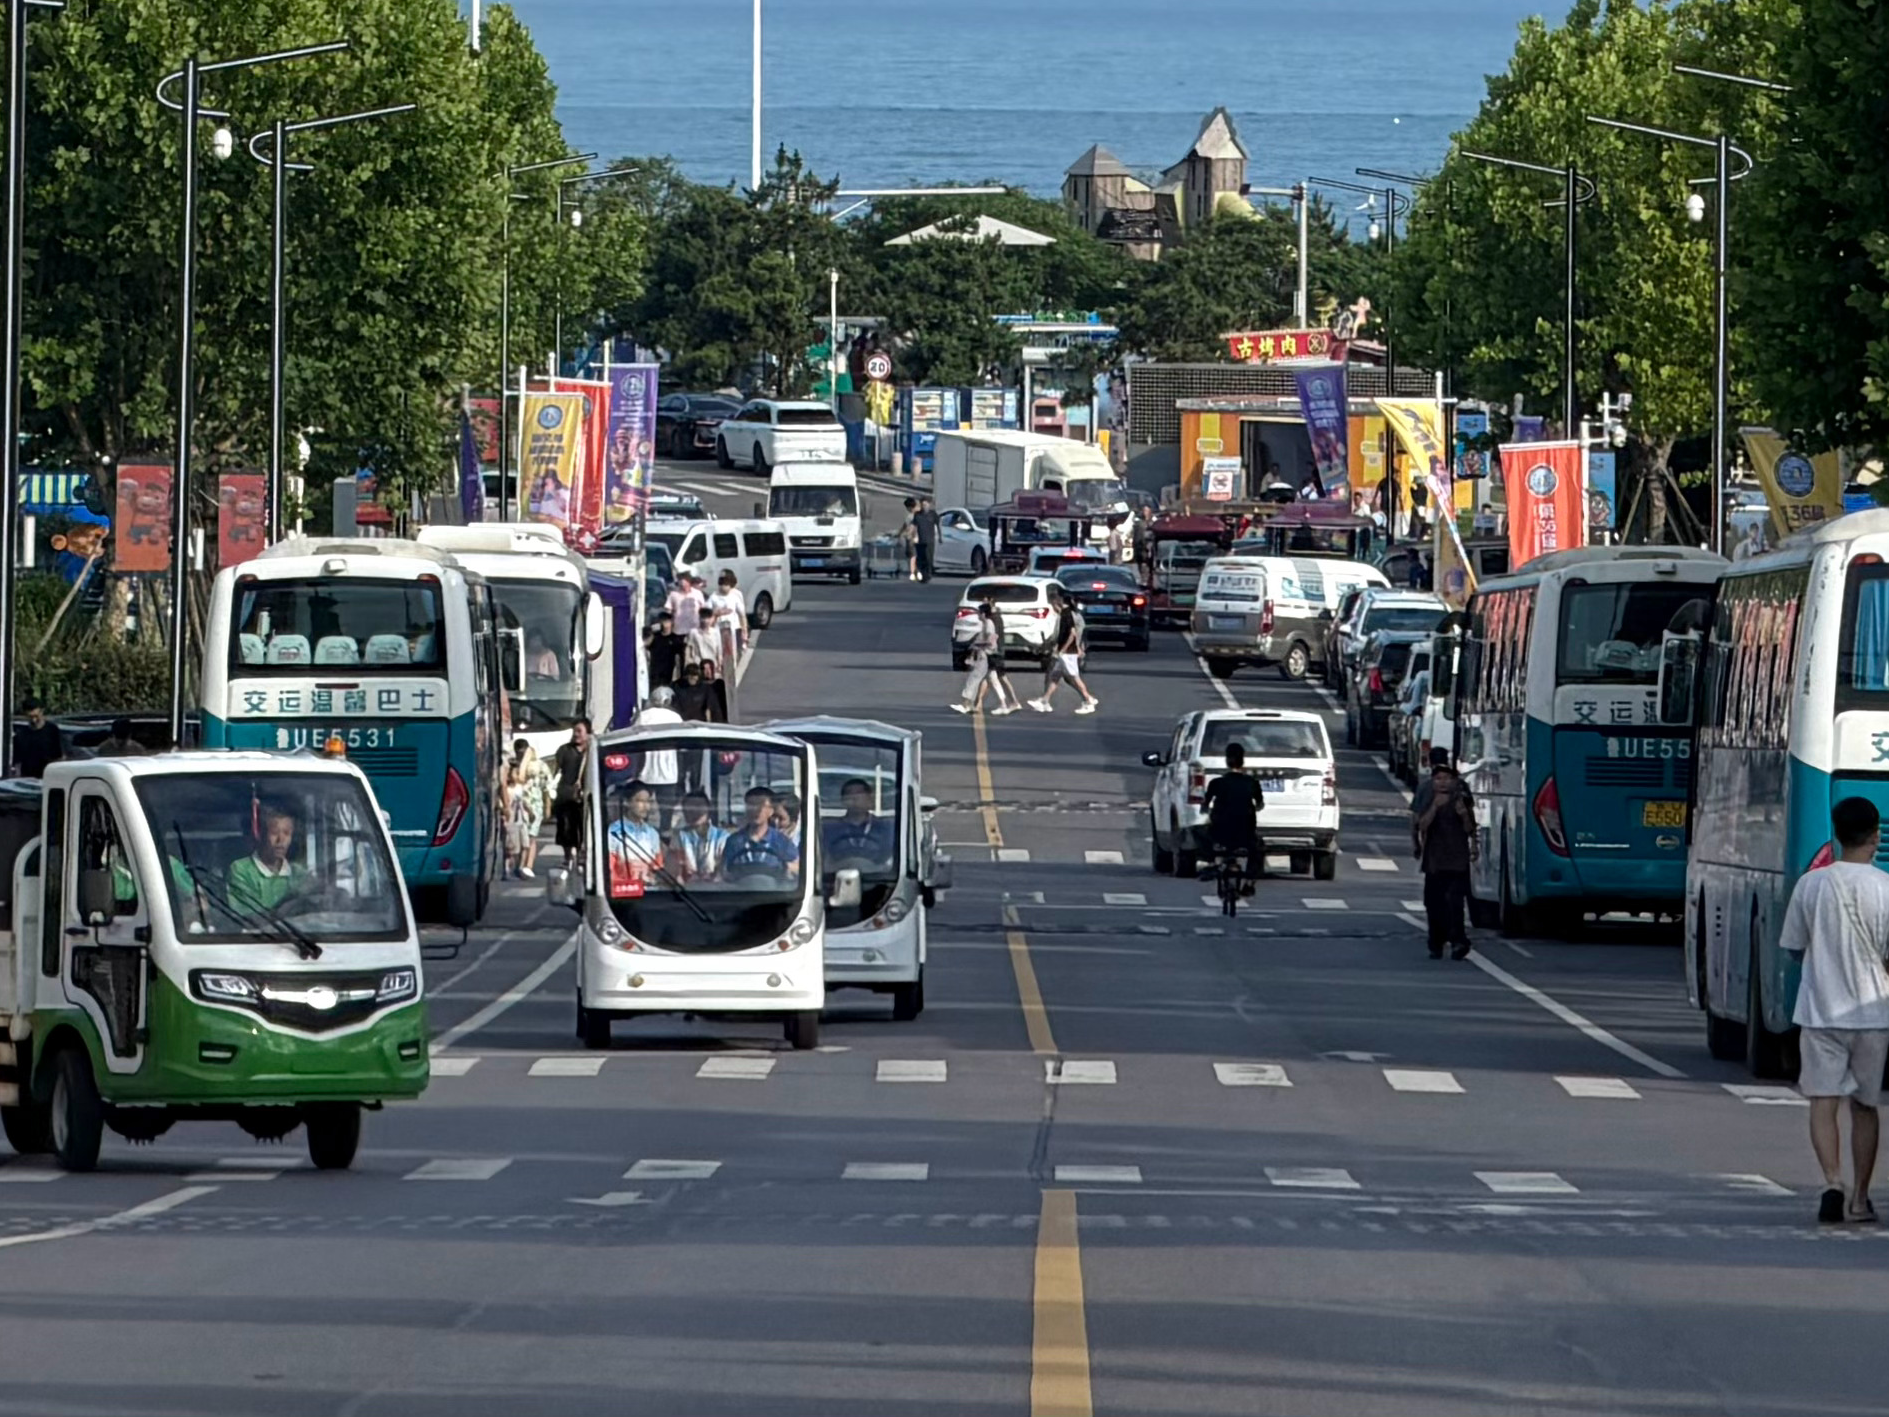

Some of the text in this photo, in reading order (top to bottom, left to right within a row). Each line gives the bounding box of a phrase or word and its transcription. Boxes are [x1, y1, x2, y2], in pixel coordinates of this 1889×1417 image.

[869, 361, 886, 373] 20
[243, 688, 435, 713] 交运温馨巴士
